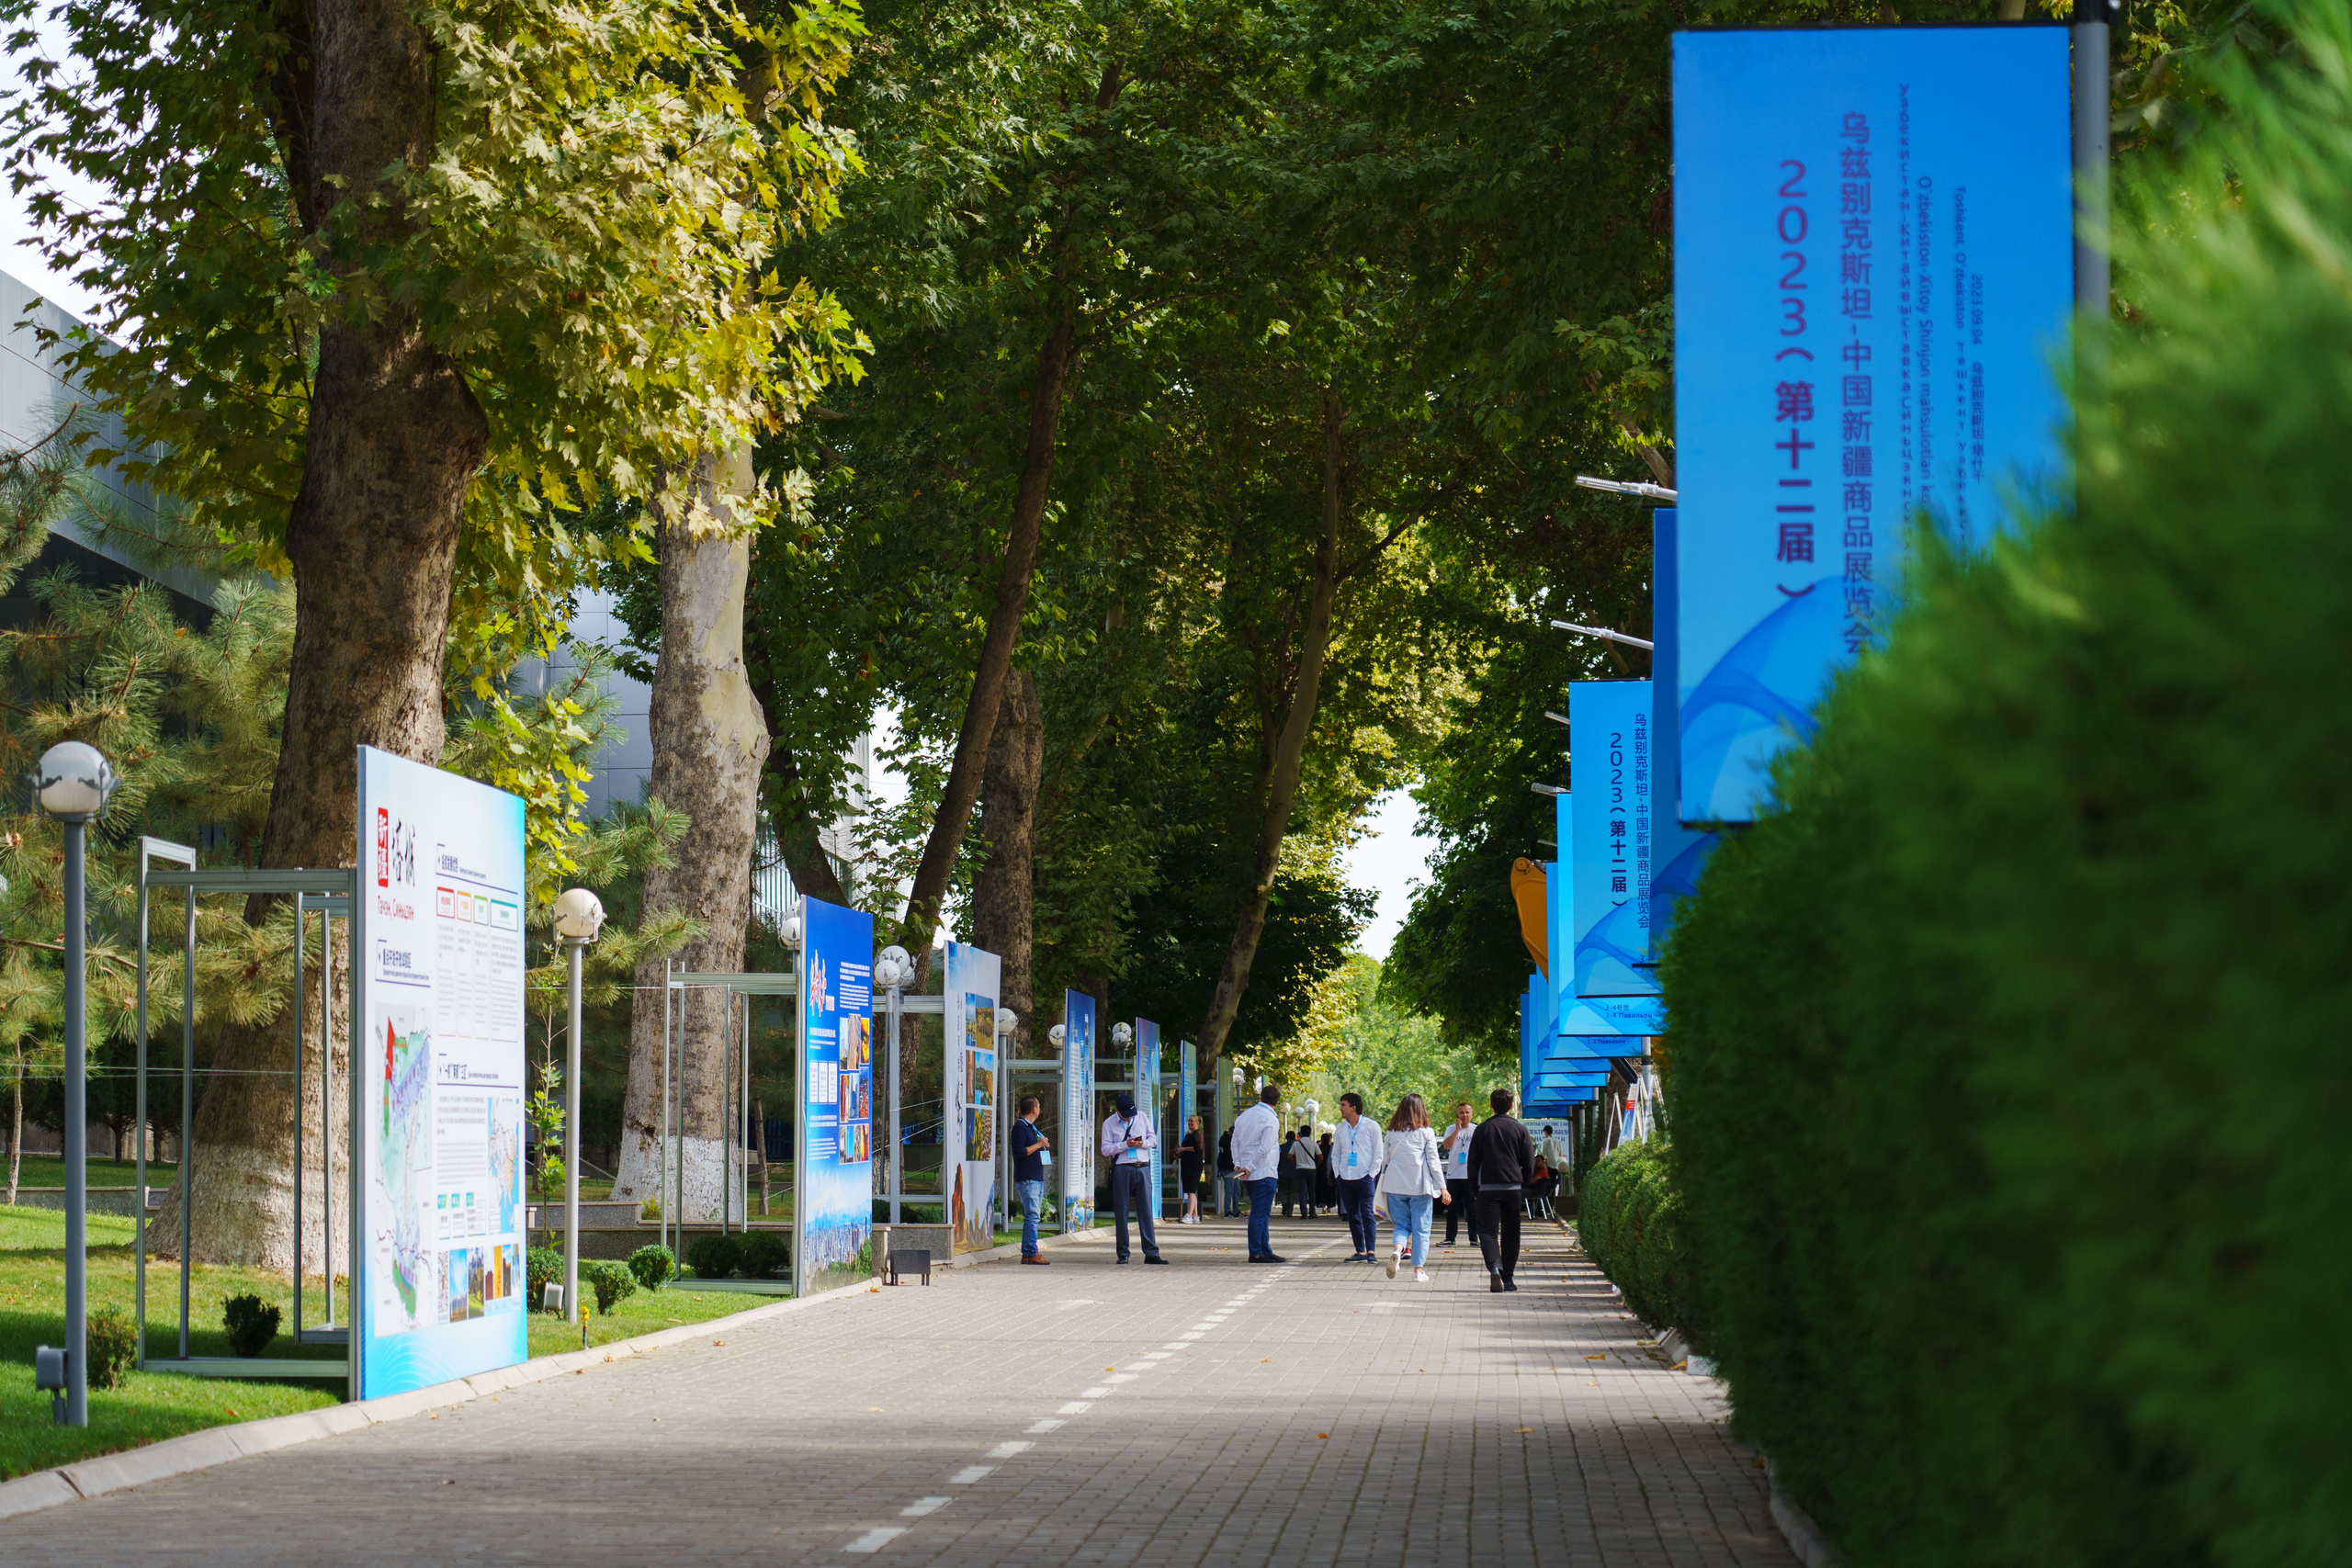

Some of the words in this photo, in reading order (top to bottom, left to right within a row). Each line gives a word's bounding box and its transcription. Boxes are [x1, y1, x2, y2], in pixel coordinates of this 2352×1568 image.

[1840, 111, 1874, 654] 乌兹别克斯坦-中国新疆商品展览会
[1634, 713, 1650, 930] 乌兹别克斯坦-中国新疆商品展览会
